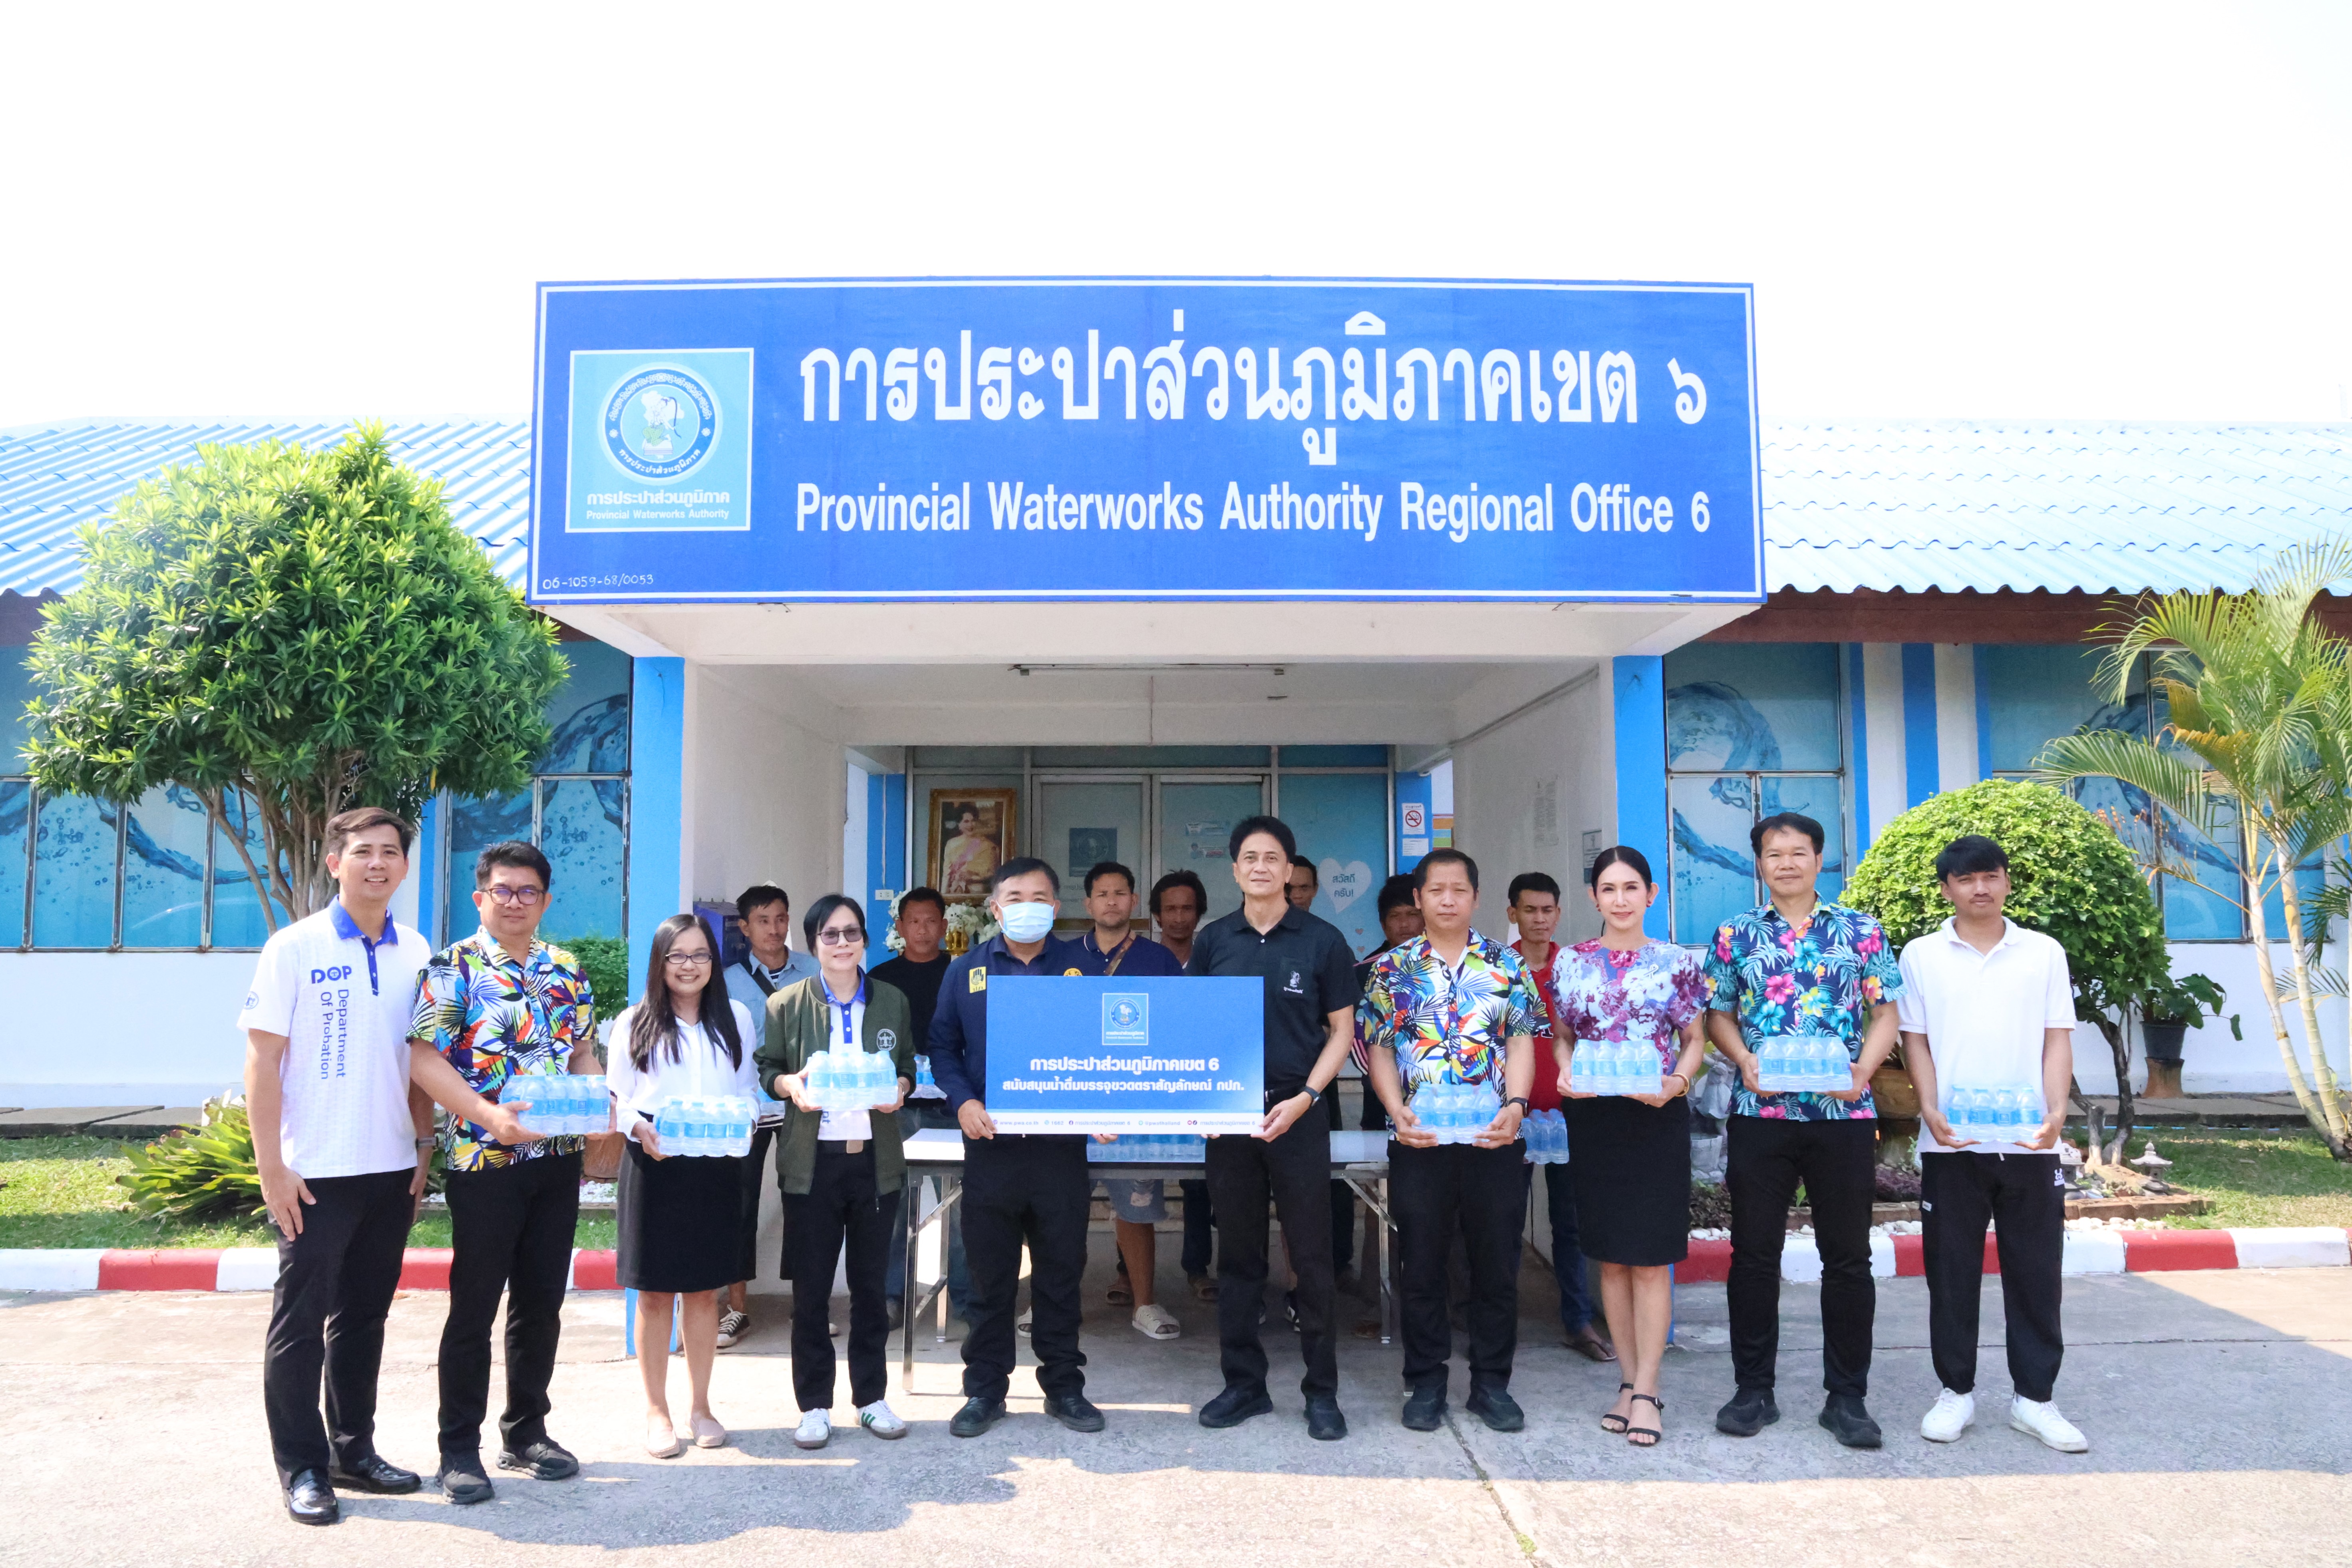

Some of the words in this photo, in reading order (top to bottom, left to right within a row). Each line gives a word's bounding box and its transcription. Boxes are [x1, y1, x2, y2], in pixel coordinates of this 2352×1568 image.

[801, 309, 1637, 465] การประปาส่วนภูมิภาคเขต
[1667, 358, 1707, 424] ๖
[587, 490, 730, 507] การประปาส่วนภูมิภาค
[586, 509, 629, 520] Provincial
[633, 509, 685, 519] Waterworks
[688, 509, 729, 520] Authority
[797, 482, 969, 531] Provincial
[988, 482, 1203, 530] Waterworks
[1220, 482, 1383, 541] Authority
[1401, 482, 1553, 543] Regional
[1571, 483, 1673, 532] Office
[1691, 491, 1710, 532] 6
[543, 573, 653, 589] 06-1059-68/0053
[311, 966, 352, 983] DOP
[321, 992, 332, 1006] Of
[336, 989, 349, 1077] Department
[321, 1013, 333, 1079] Probation
[1030, 1055, 1205, 1075] การประปาส่วนภูมิภาคเขต
[1208, 1058, 1219, 1071] 6
[1002, 1076, 1212, 1094] สนับสนุนน้ำดื่มบรรจุขวดตราสัญลักษณ์
[1217, 1080, 1245, 1090] กปภ.
